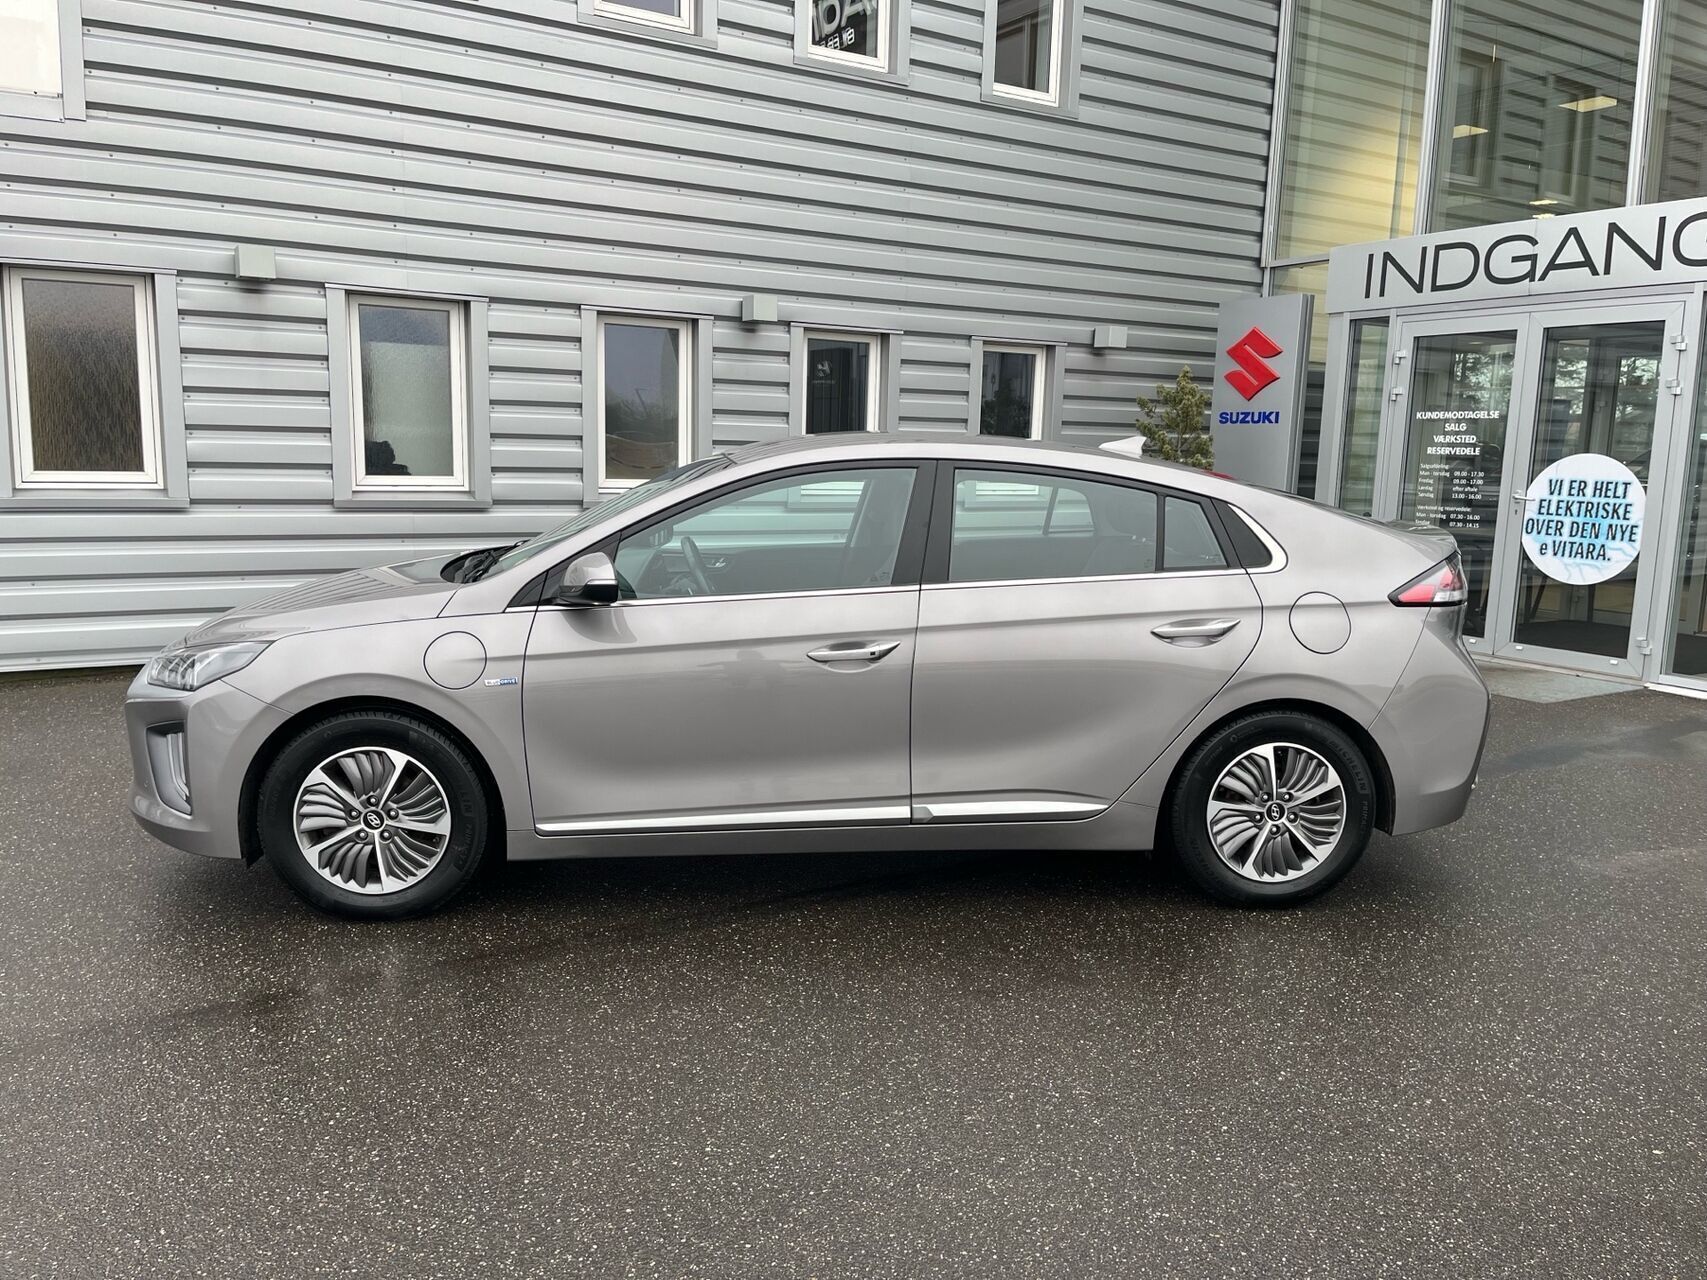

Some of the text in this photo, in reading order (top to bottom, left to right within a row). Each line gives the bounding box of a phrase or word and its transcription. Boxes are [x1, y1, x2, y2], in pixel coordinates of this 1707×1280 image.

[1219, 411, 1279, 425] SUZUKI
[1416, 411, 1500, 419] KUNDEMODTAGELSE
[1445, 423, 1467, 431] SALG
[1433, 435, 1477, 443] VÆRKSTED
[1427, 447, 1480, 455] RESERVEDELE
[1548, 479, 1631, 499] VI ER HELT
[1538, 499, 1633, 521] ELEKTRISKE
[1525, 518, 1639, 543] OVER DEN NYE
[1540, 540, 1611, 561] e VITARA.
